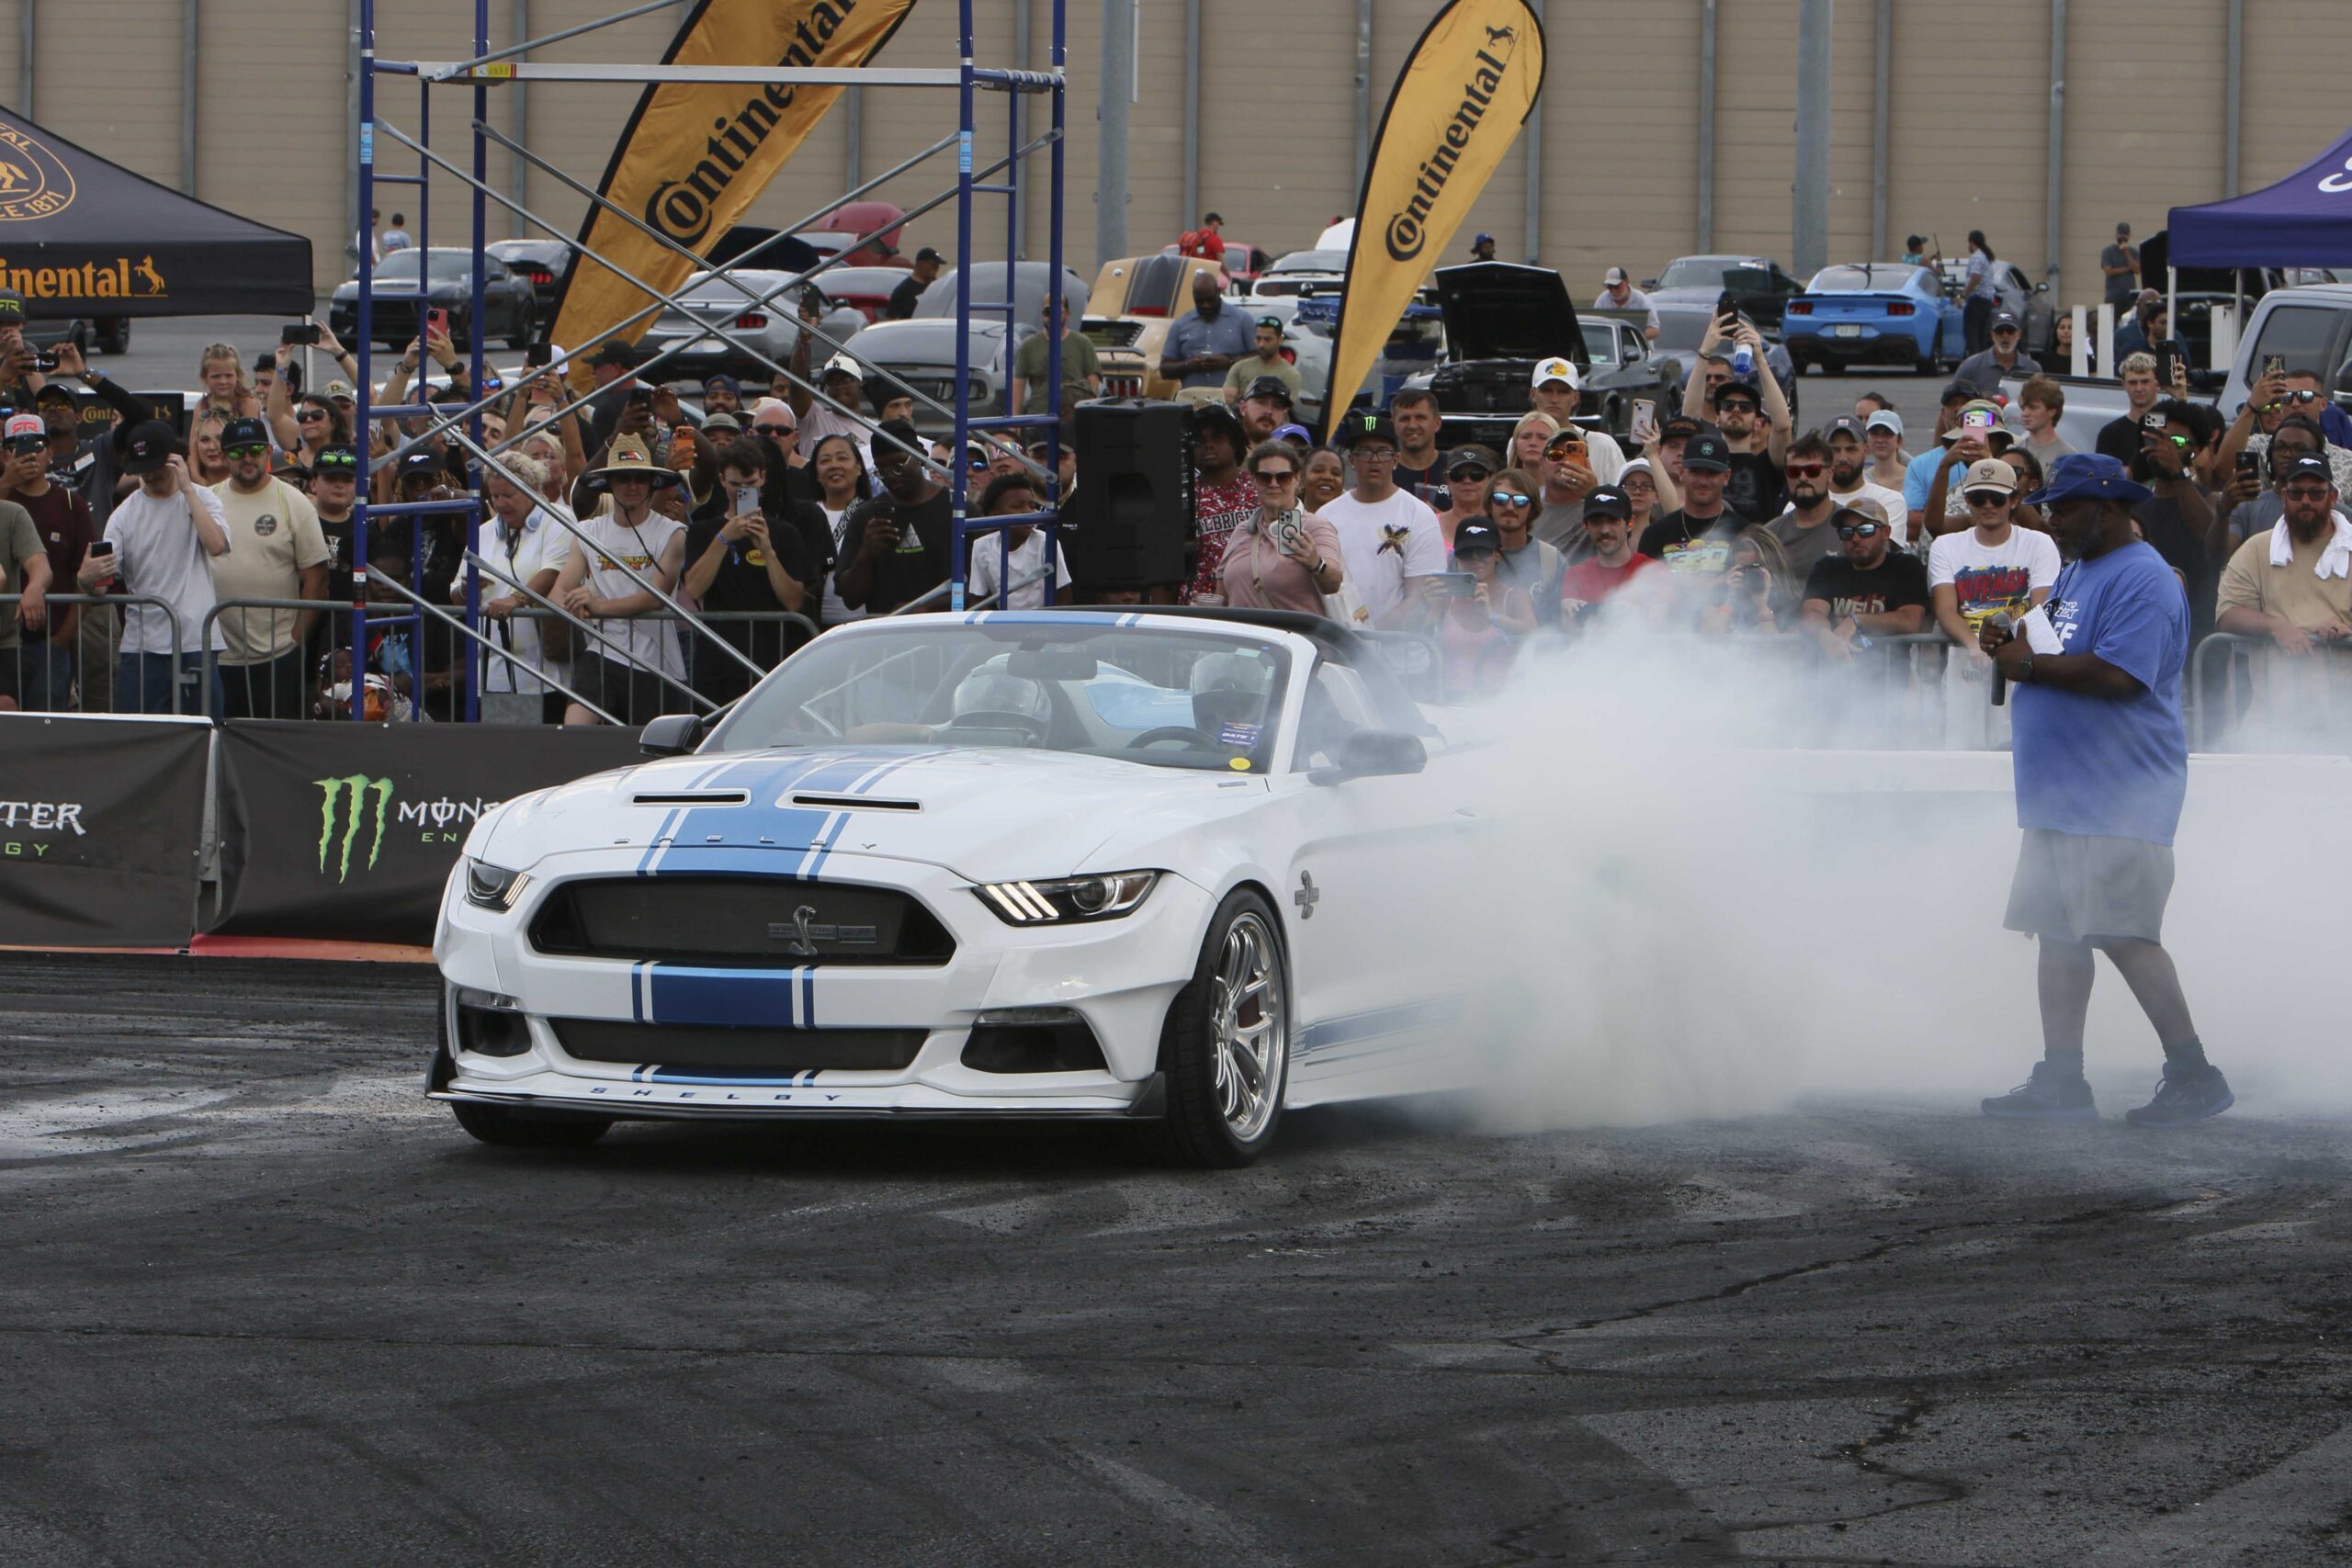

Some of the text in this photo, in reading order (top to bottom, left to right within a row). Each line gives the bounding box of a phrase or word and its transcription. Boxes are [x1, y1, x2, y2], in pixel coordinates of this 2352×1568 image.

[1385, 50, 1507, 262] Continental
[25, 190, 65, 214] 1871
[422, 832, 458, 842] EN
[5, 841, 49, 857] GY
[590, 1087, 842, 1101] SHELBY
